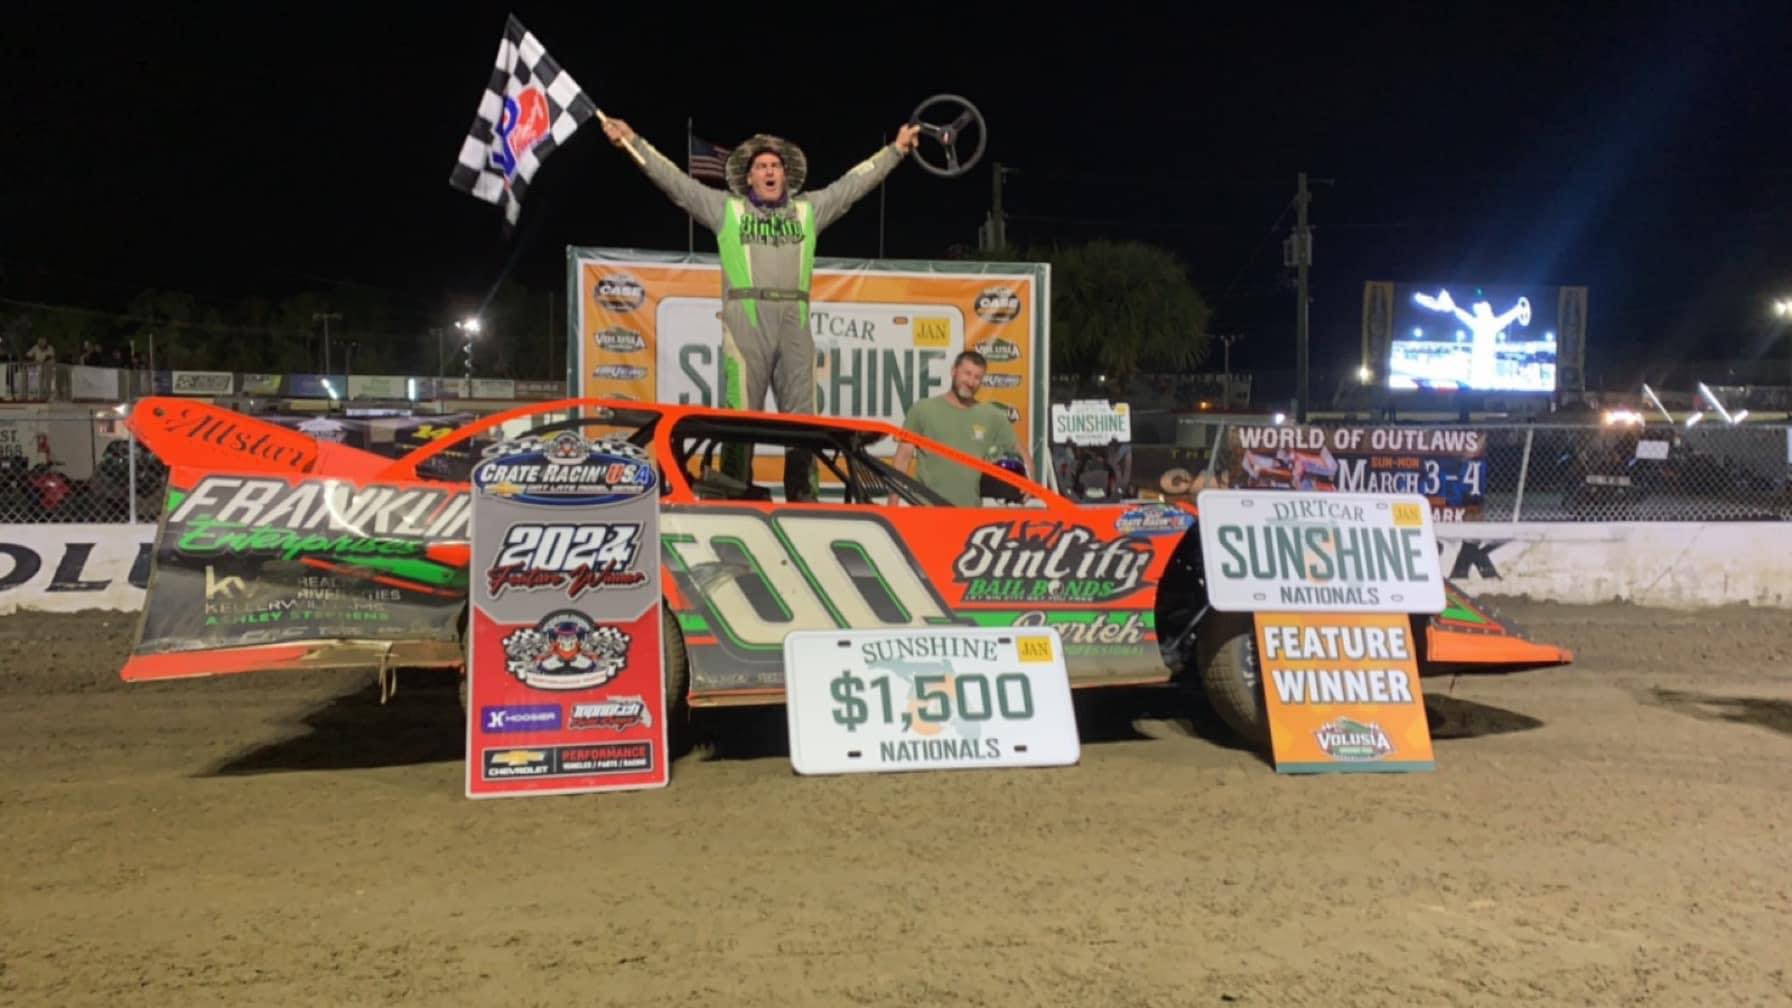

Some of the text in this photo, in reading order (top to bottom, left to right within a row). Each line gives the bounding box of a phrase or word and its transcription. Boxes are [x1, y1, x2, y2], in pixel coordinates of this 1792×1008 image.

[811, 312, 875, 342] TCAR
[917, 325, 946, 339] JAN
[679, 344, 946, 417] SHINE
[1057, 415, 1126, 432] SUNSHINE
[1240, 427, 1478, 450] WORLD OF OUTLAWS
[480, 463, 541, 482] CRATE
[1371, 457, 1419, 468] SUN-MON
[1338, 459, 1420, 494] MARCH
[169, 477, 471, 537] FRANKLIN
[1217, 525, 1429, 582] SUNSHINE
[968, 579, 1025, 597] BAIL
[1280, 586, 1380, 605] NATIONALS
[862, 637, 997, 663] SUNSHINE
[1022, 642, 1049, 656] JAN
[1264, 626, 1408, 660] FEATURE
[1272, 669, 1413, 703] WINNER
[830, 670, 1034, 732] $1,500
[880, 738, 1000, 762] NATIONALS
[1317, 731, 1391, 750] VOLUSIA
[562, 746, 646, 760] PERFORMANCE
[488, 765, 549, 776] CHEVROLET
